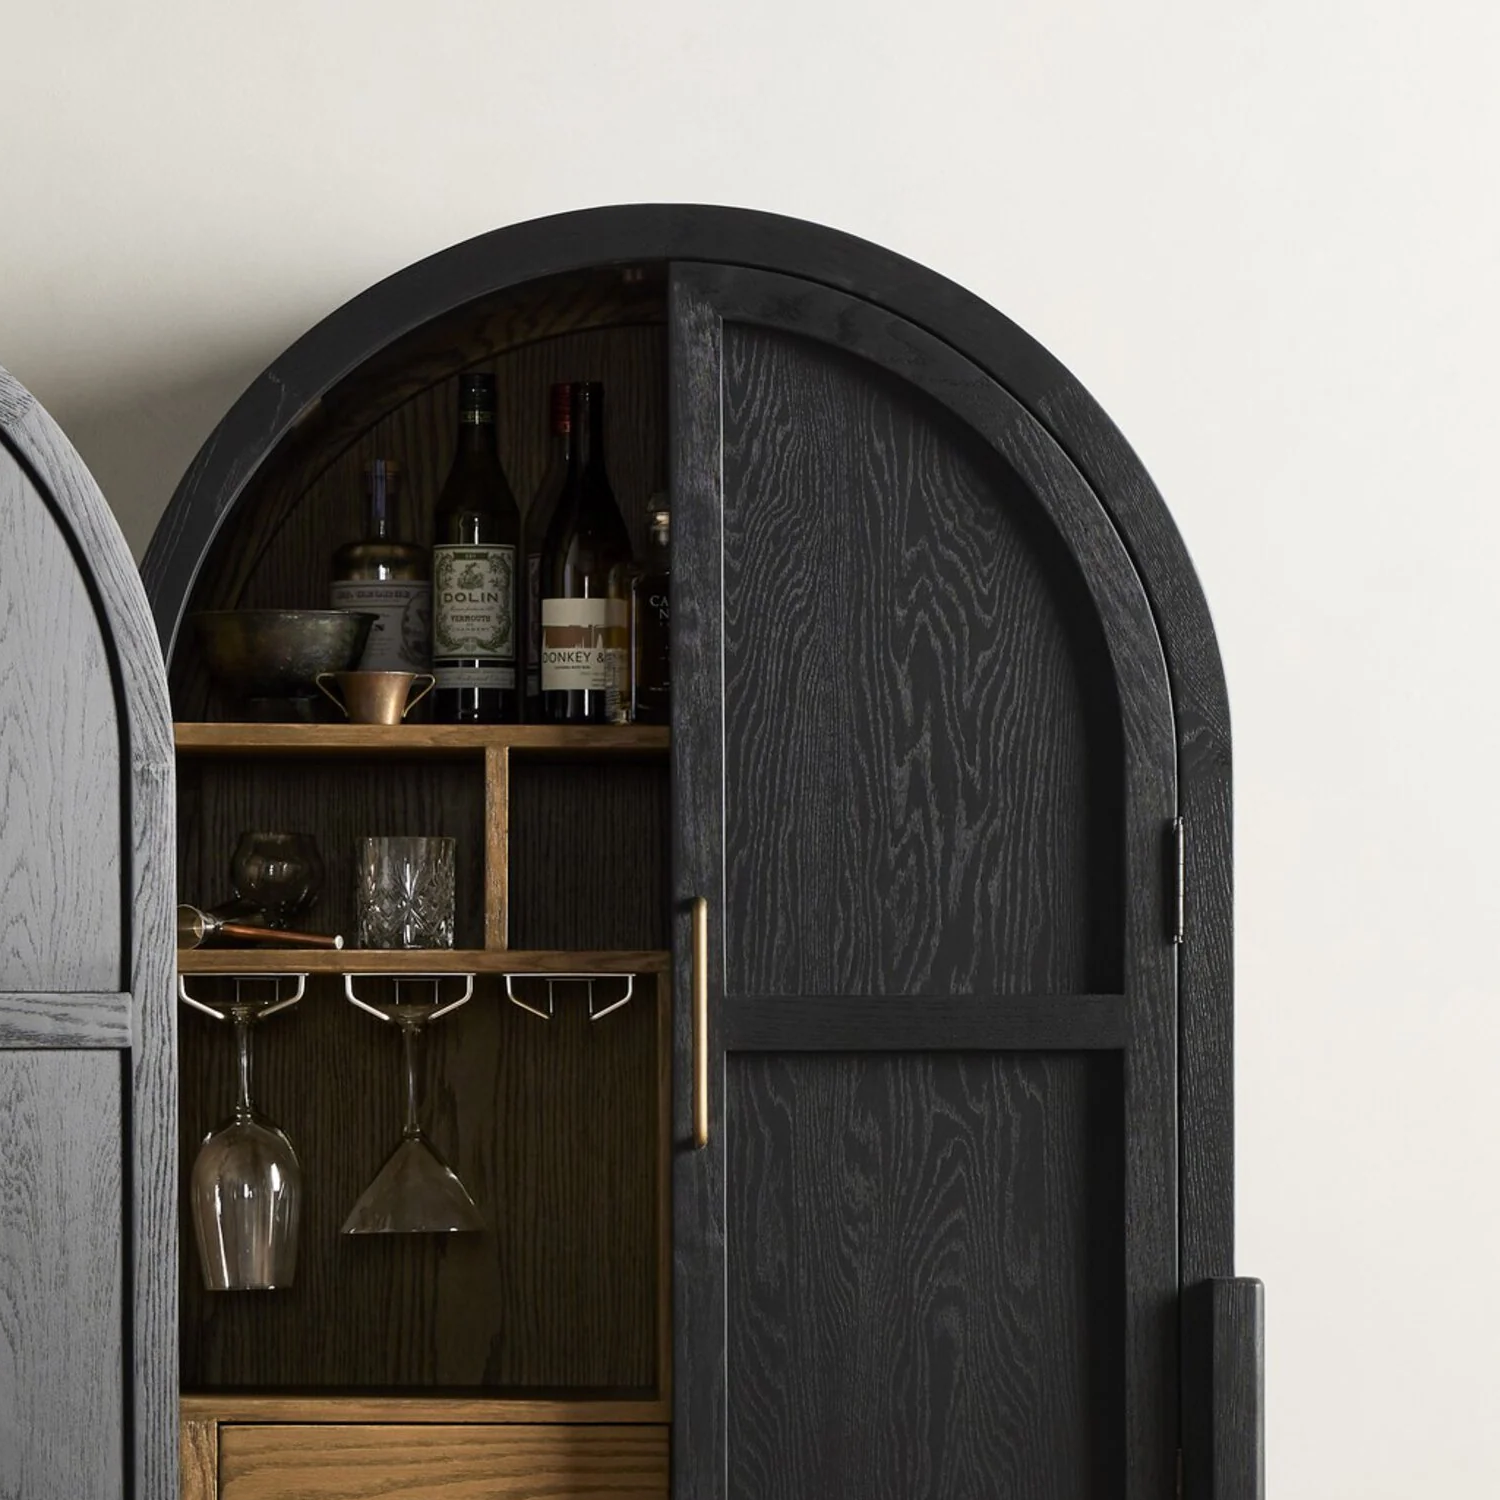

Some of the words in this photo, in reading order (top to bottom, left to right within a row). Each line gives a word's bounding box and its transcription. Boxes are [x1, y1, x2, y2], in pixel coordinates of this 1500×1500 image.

[444, 592, 499, 604] DOLIN
[542, 651, 592, 664] DONKEY
[596, 651, 605, 664] &
